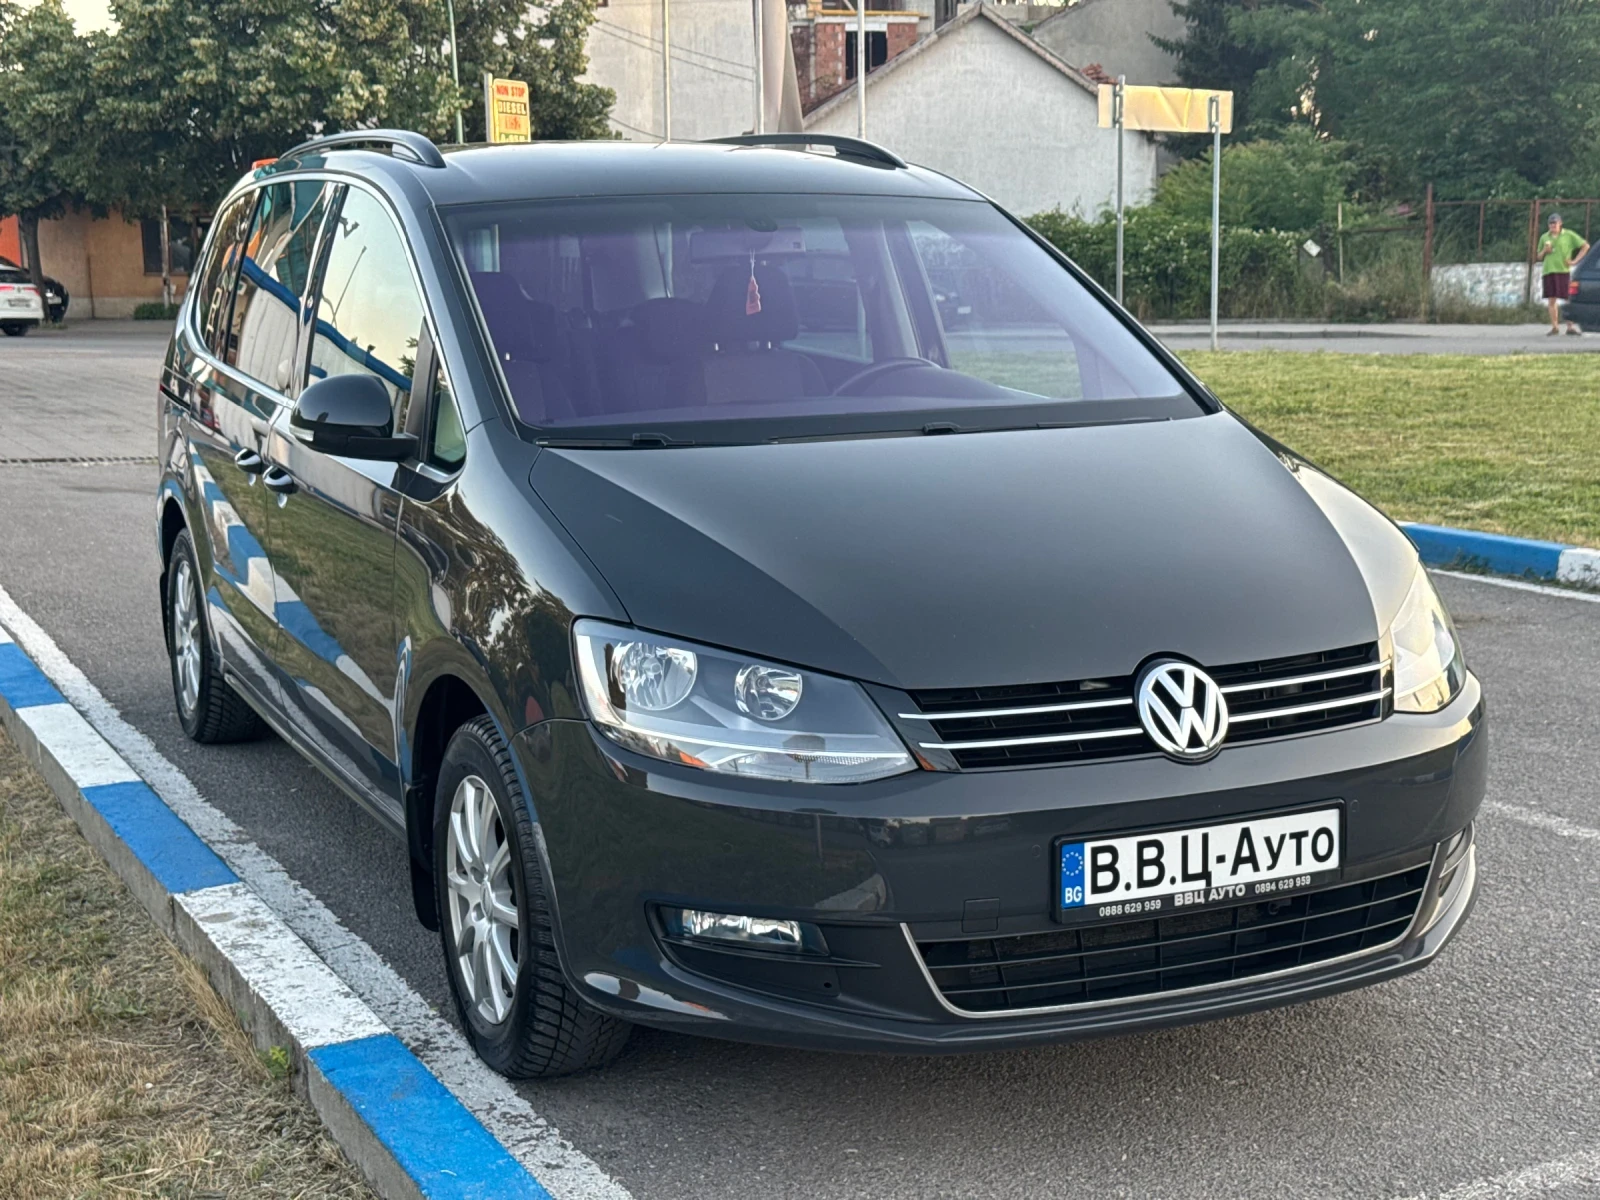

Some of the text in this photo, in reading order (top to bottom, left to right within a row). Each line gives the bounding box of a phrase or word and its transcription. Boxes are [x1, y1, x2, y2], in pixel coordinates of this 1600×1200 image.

[496, 85, 525, 97] NON STOP
[498, 101, 526, 115] DIESEL
[1091, 826, 1334, 895] В.В.Ц-Ауто
[1255, 875, 1311, 894] 0894 629 959
[1065, 886, 1082, 903] BG
[1174, 884, 1246, 906] ВВЦ АУТО
[1099, 899, 1161, 917] 0888 629 959
